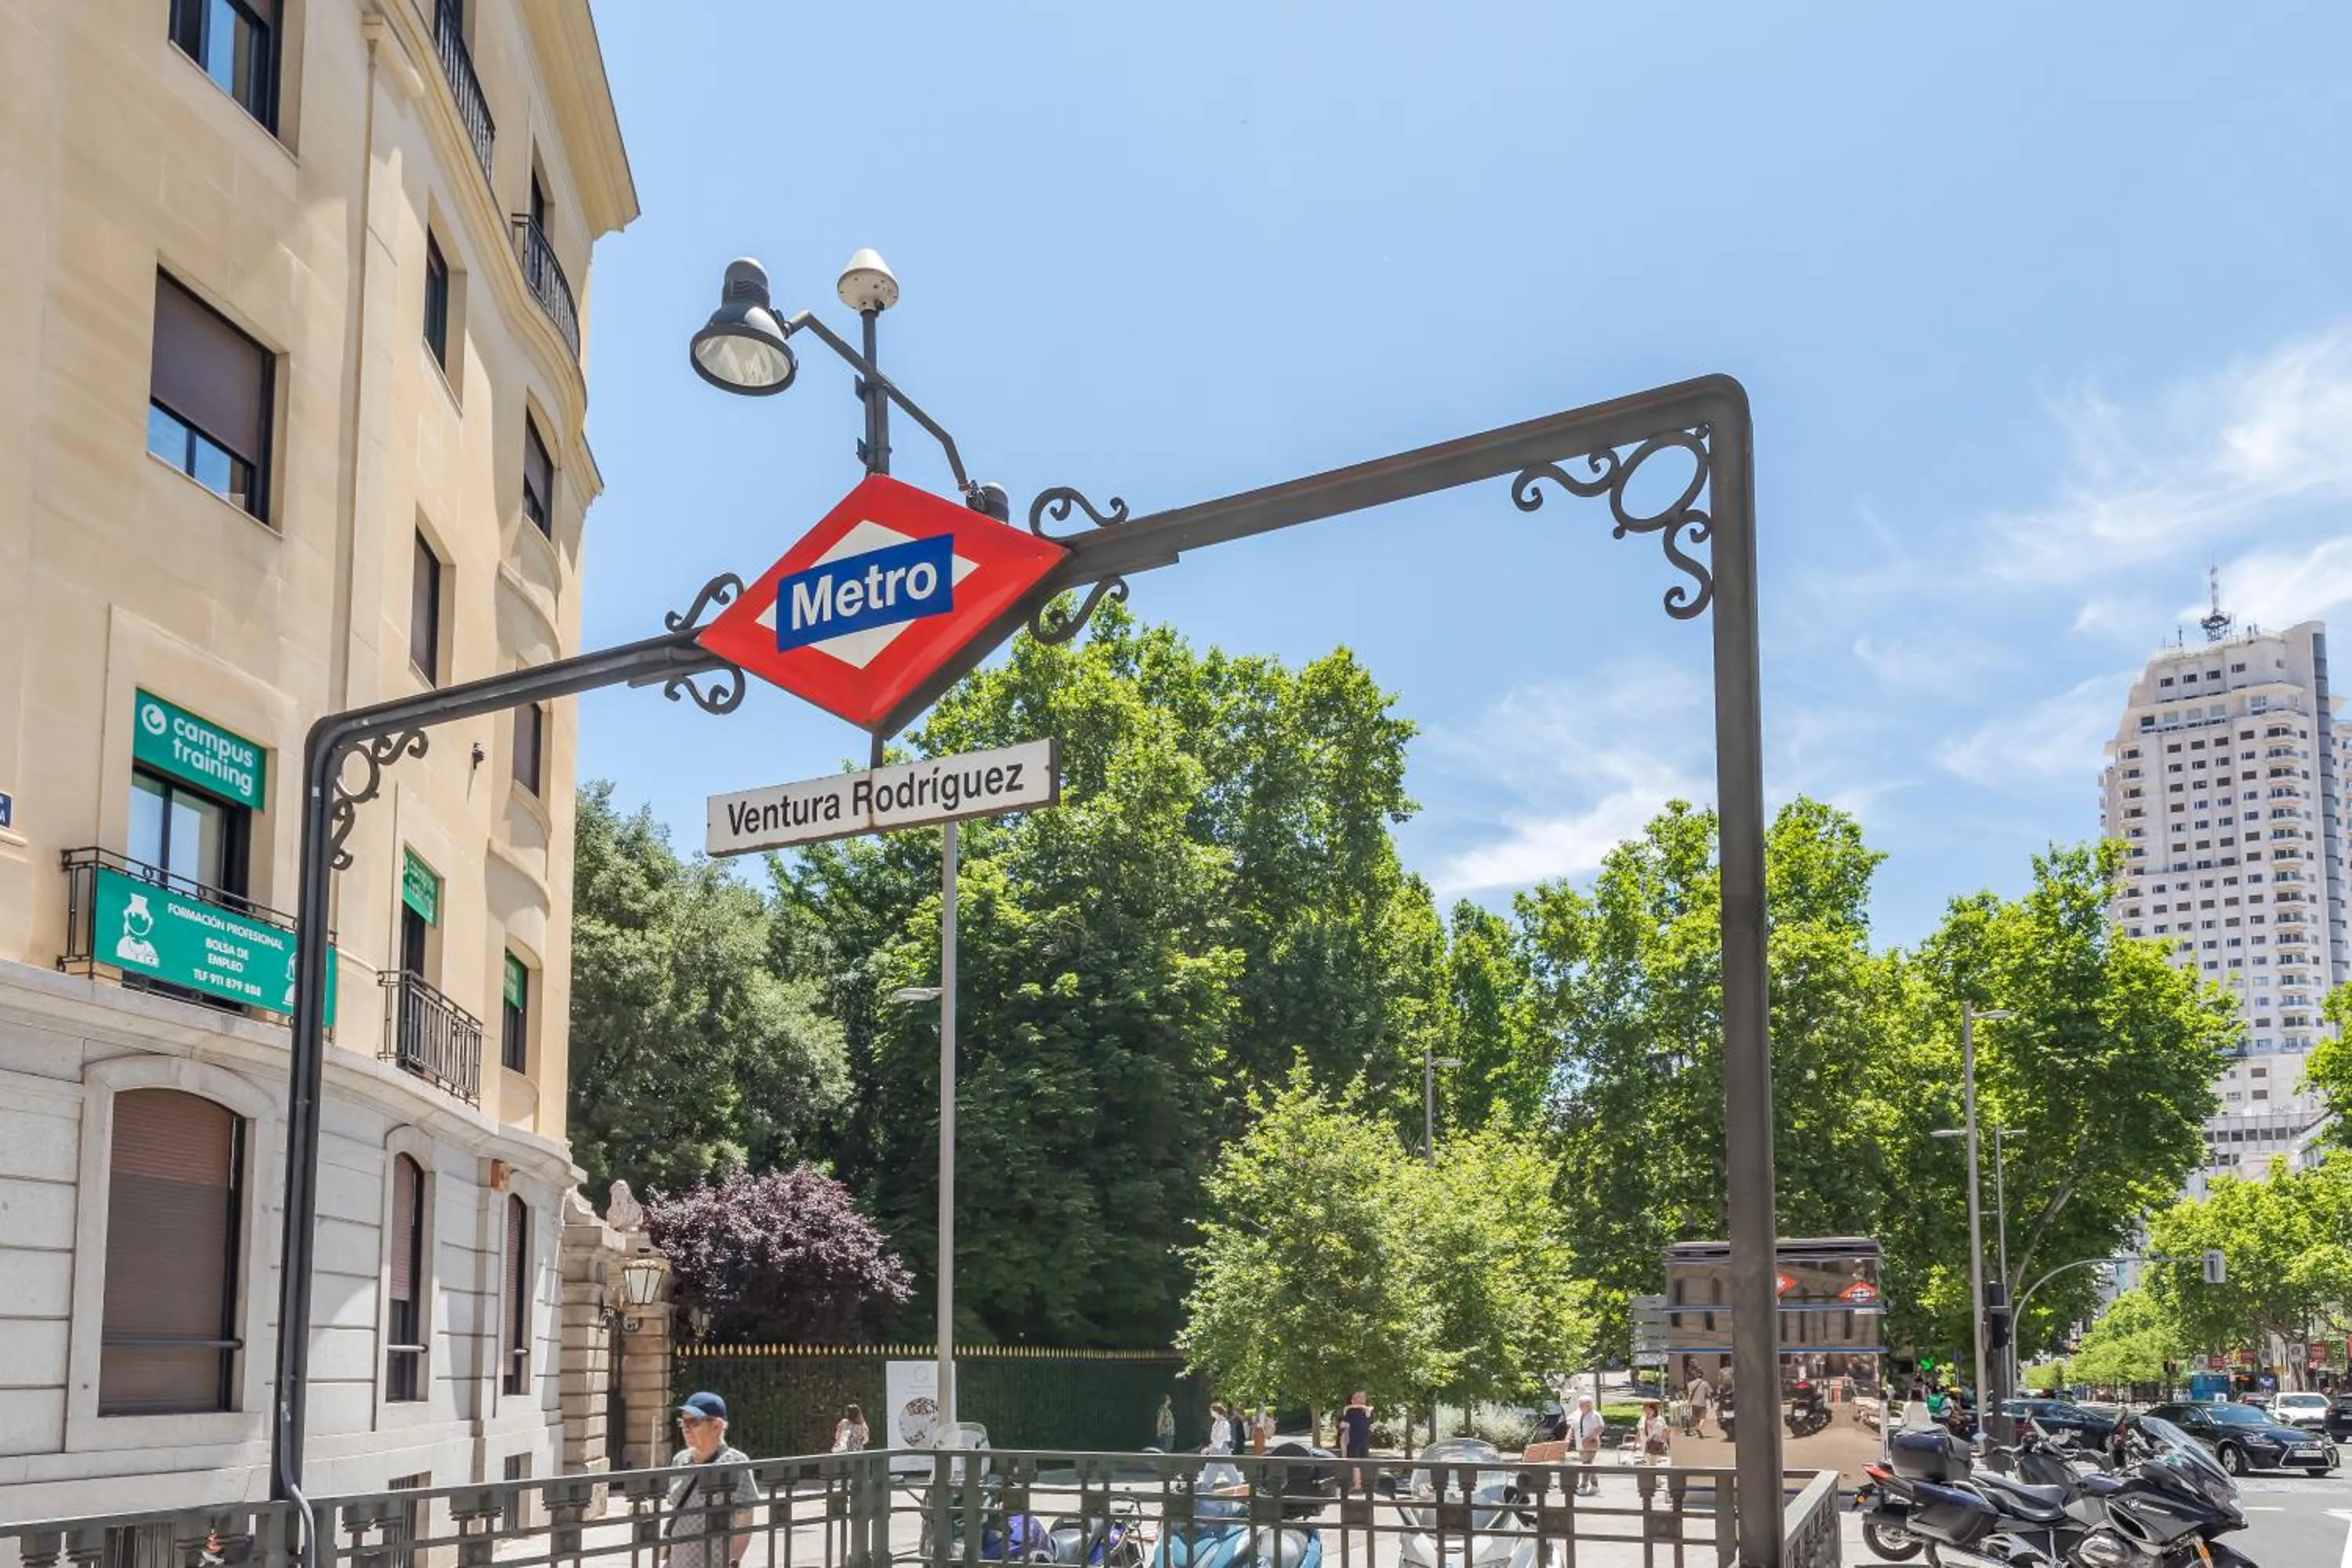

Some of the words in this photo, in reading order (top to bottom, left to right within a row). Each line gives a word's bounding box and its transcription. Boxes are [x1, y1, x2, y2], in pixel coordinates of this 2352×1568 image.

[792, 562, 937, 630] Metro
[172, 737, 253, 797] training
[173, 717, 253, 768] campus
[728, 792, 840, 836] Ventura
[852, 762, 1024, 815] Rodríguez
[167, 902, 225, 931] FORMACIÓN
[226, 921, 285, 951] PROFESIONAL
[205, 937, 235, 955] BOLSA
[236, 948, 249, 960] DE
[207, 953, 244, 973] EMPLEO
